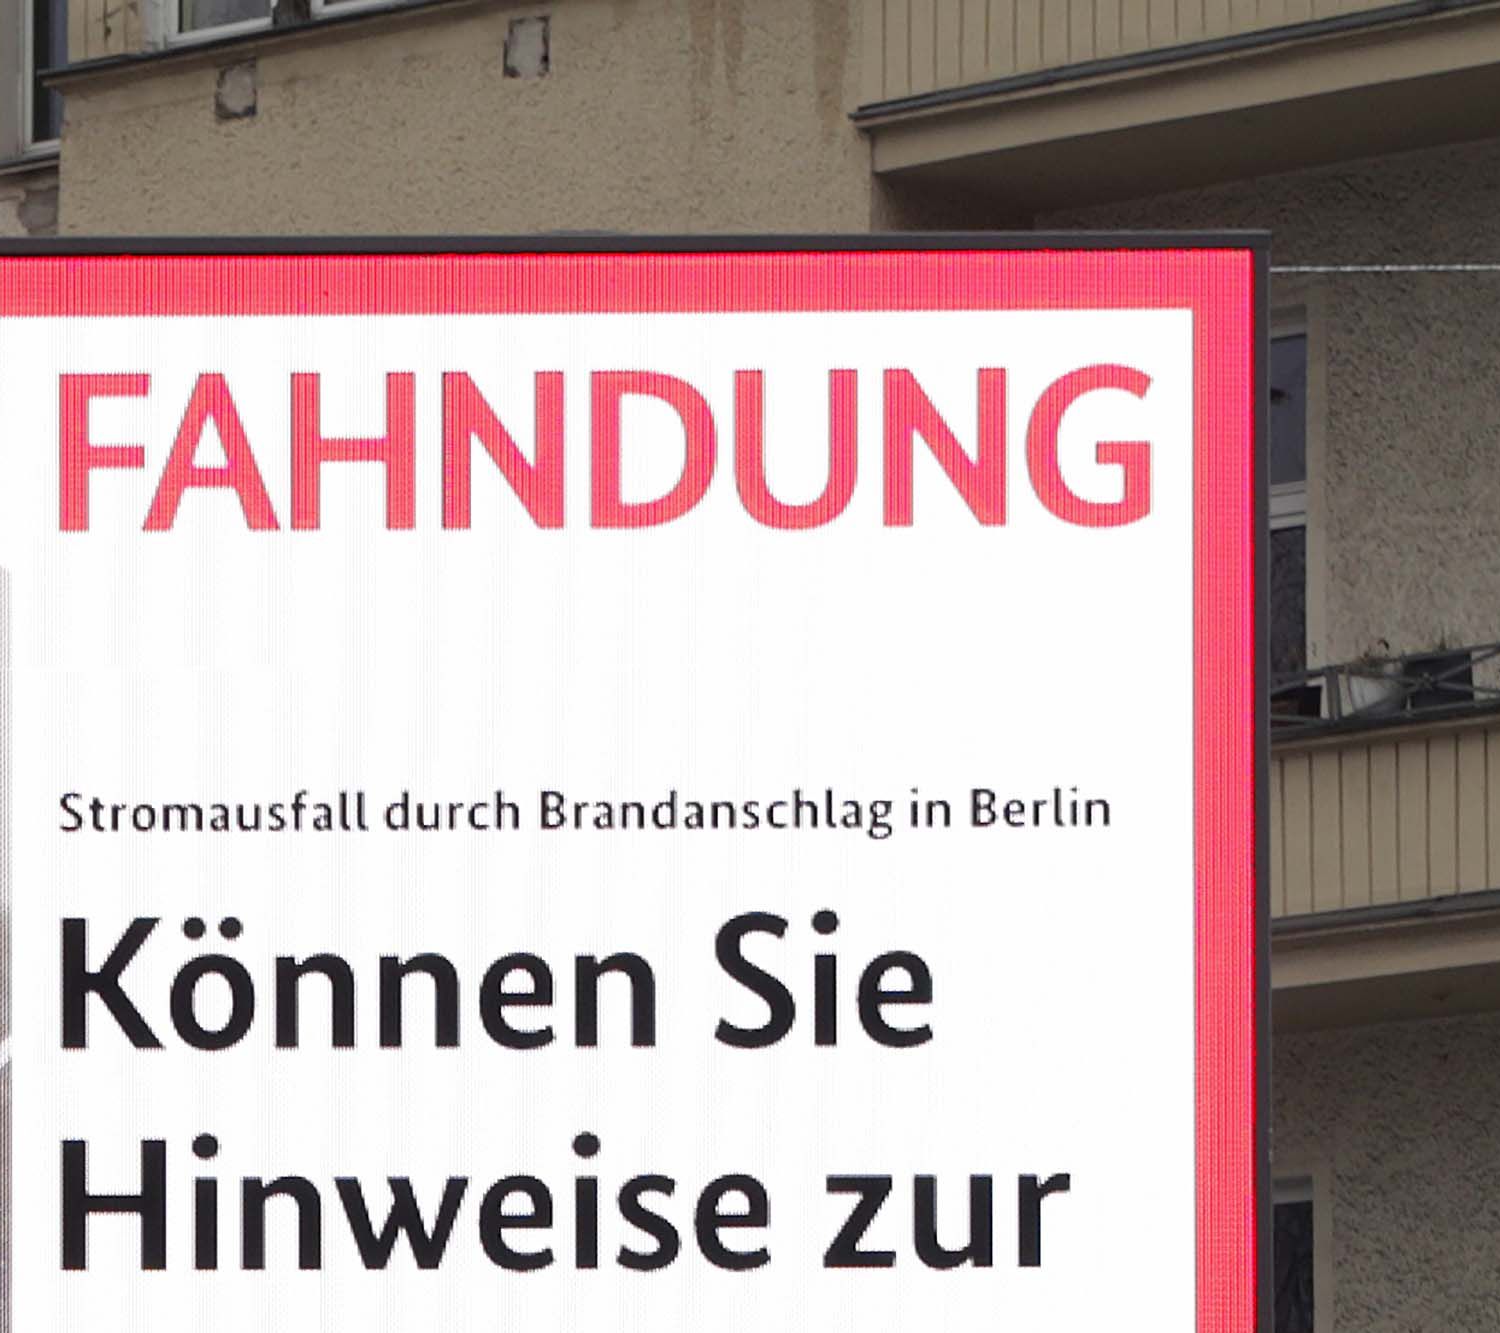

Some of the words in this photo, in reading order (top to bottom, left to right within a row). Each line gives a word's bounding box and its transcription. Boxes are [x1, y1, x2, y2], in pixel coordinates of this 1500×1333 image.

[60, 364, 1152, 532] FAHNDUNG
[59, 788, 368, 834] Stromausfall
[384, 789, 522, 833] durch
[538, 789, 895, 839] Brandanschlag
[910, 789, 953, 831] in
[971, 787, 1111, 830] Berlin
[61, 915, 656, 1050] Können
[715, 910, 934, 1049] Sie
[62, 1132, 771, 1271] Hinweise
[824, 1173, 1071, 1270] zur
